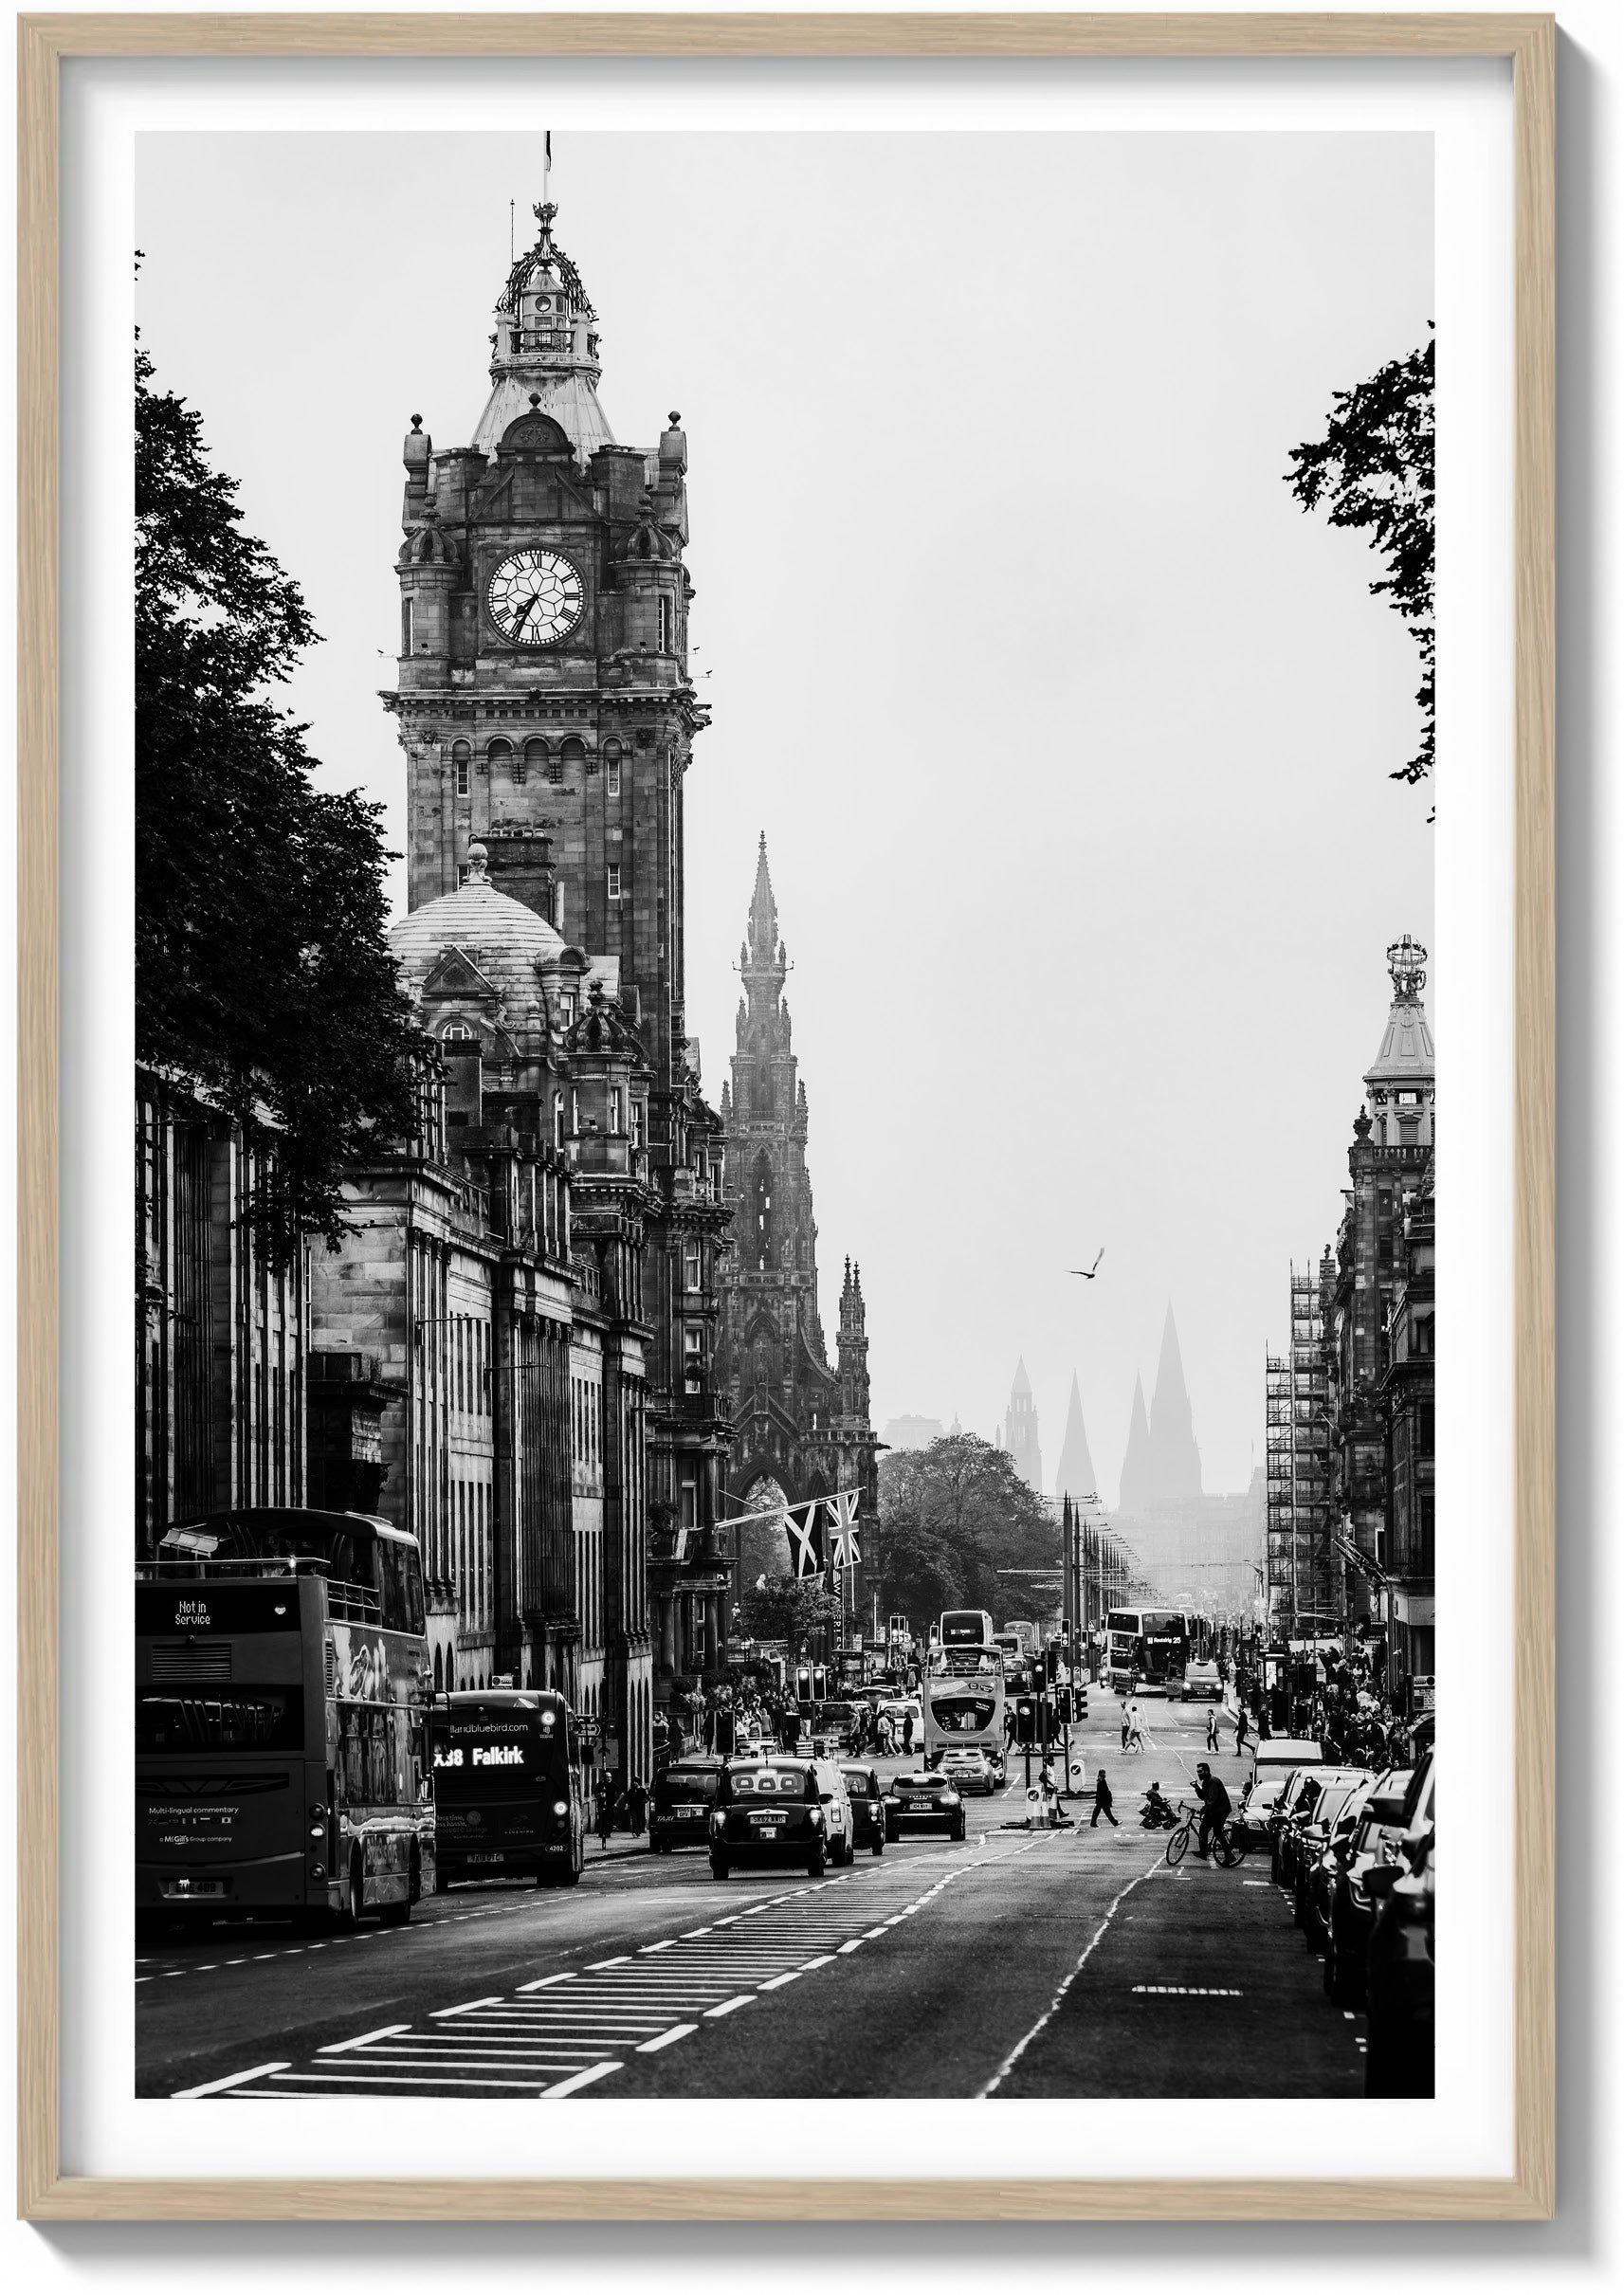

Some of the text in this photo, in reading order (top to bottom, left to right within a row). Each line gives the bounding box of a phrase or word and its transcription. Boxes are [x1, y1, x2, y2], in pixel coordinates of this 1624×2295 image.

[179, 1600, 207, 1613] Not in
[174, 1613, 211, 1625] Service
[472, 1745, 525, 1766] Falkirk
